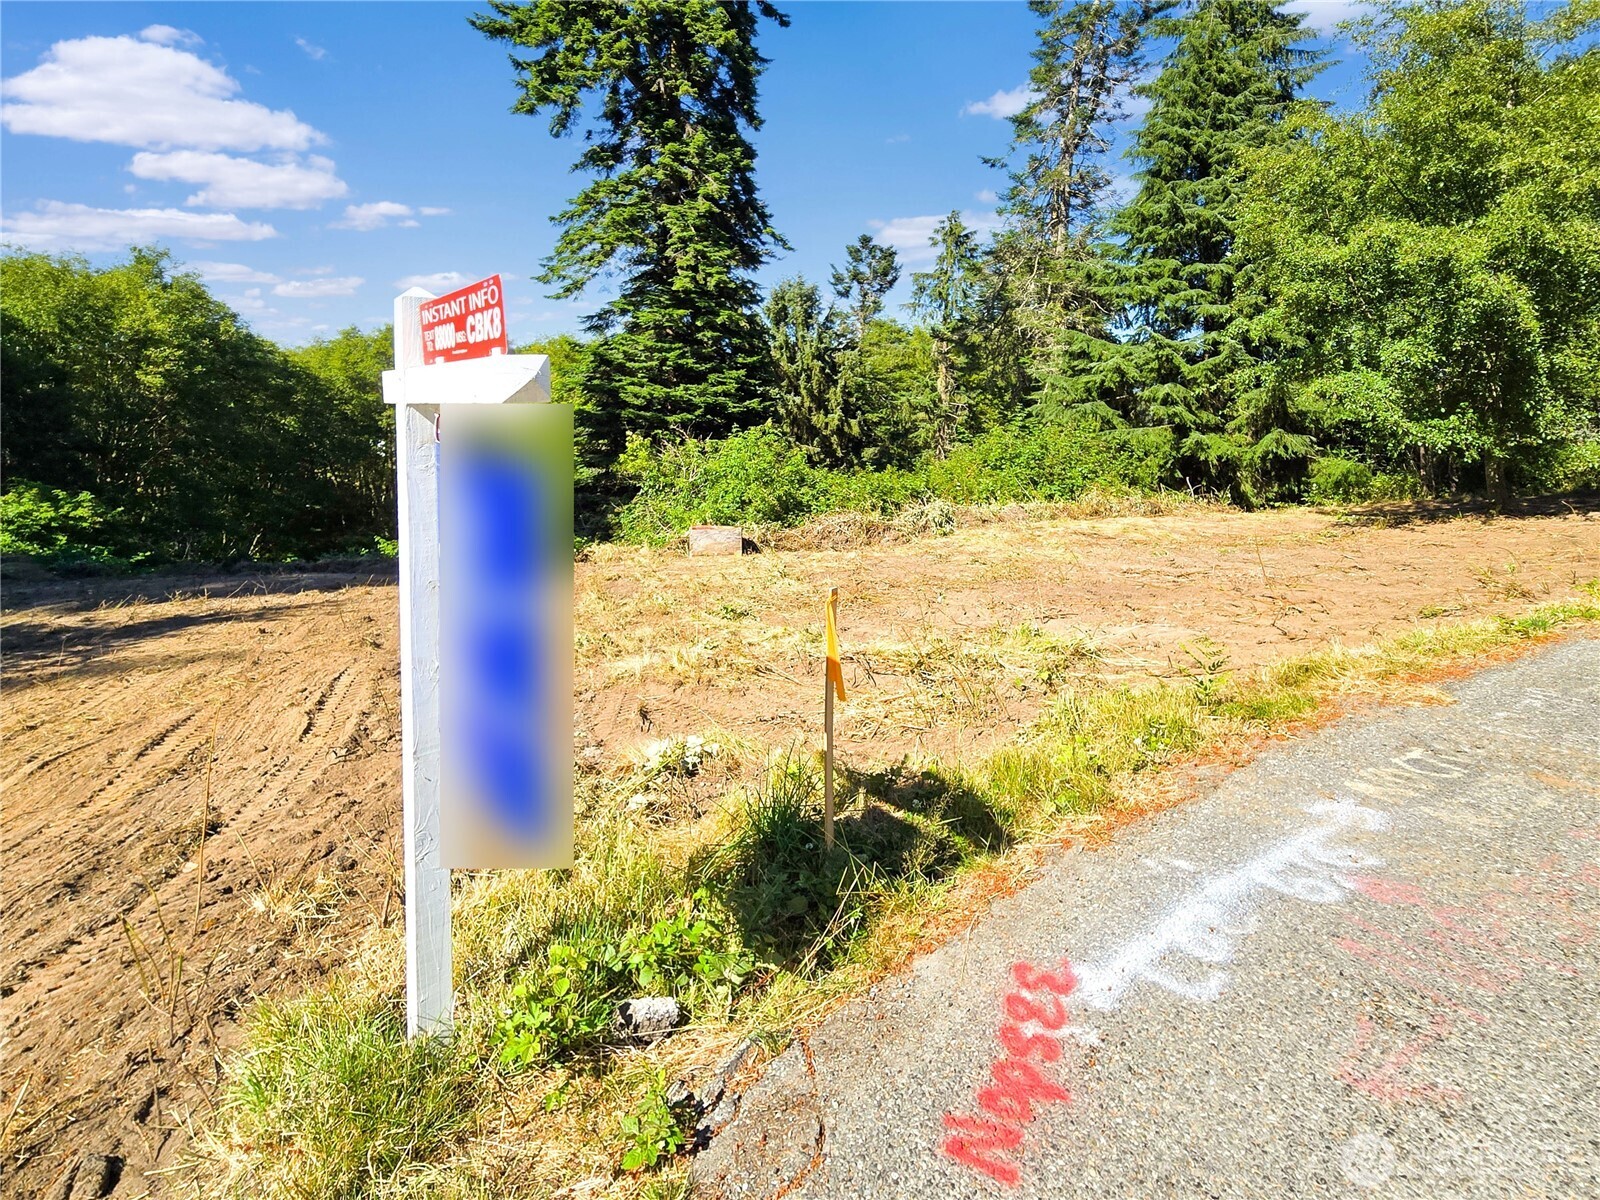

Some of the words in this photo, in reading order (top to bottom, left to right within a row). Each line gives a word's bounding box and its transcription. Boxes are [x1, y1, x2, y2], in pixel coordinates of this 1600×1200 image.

[422, 296, 466, 325] INSTANT
[468, 285, 499, 311] INFO
[466, 306, 502, 344] CBK8
